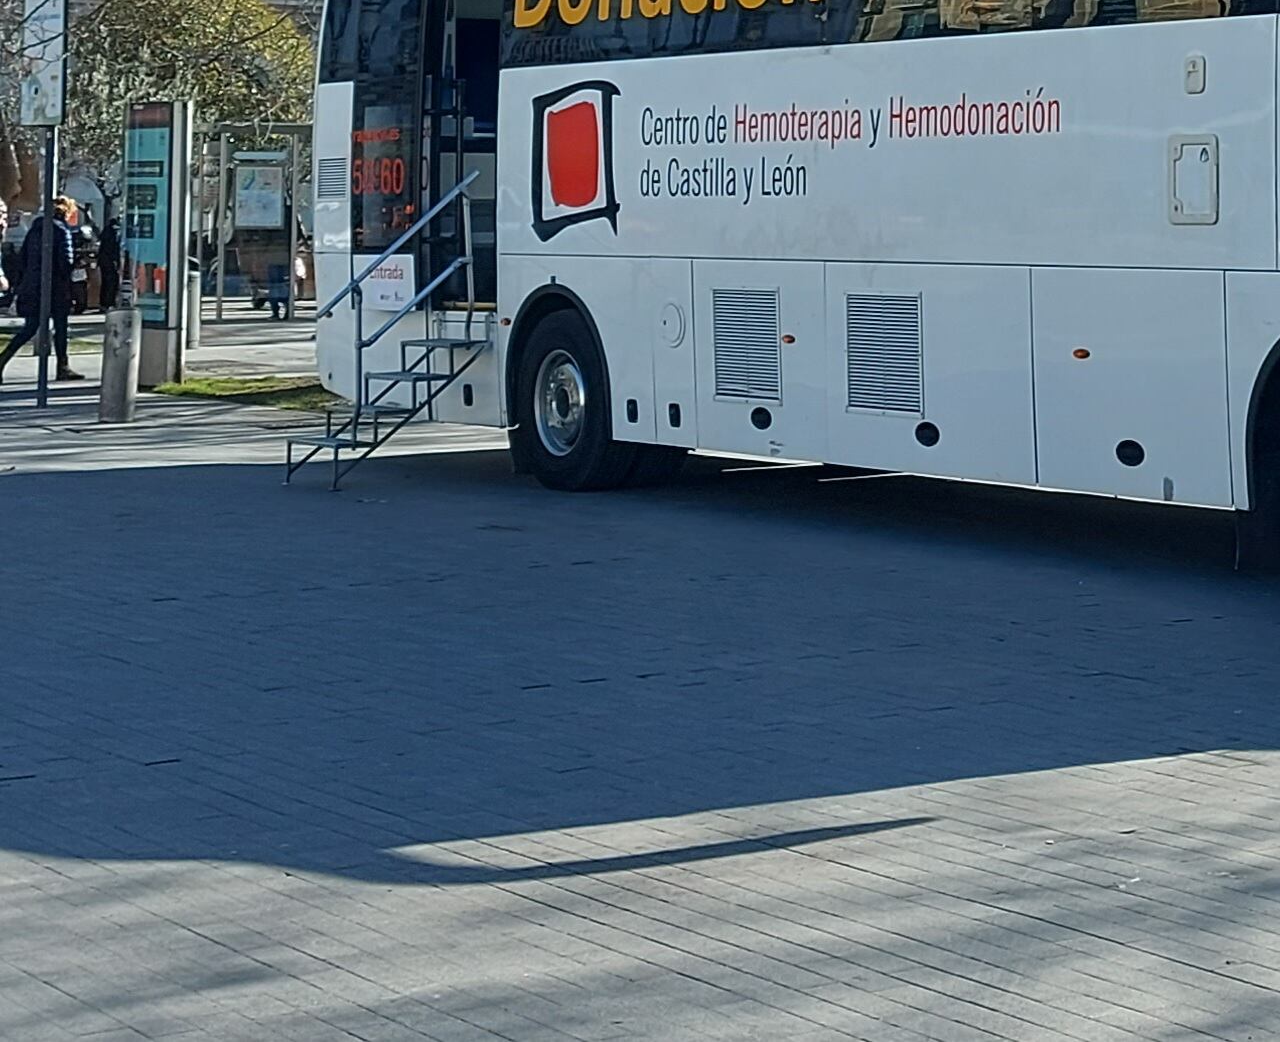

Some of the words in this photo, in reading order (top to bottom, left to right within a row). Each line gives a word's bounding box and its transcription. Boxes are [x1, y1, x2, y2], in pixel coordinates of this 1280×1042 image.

[641, 107, 699, 147] Centro
[705, 104, 728, 144] de
[734, 99, 862, 150] Hemoterapia
[869, 107, 881, 149] y
[889, 87, 1061, 140] Hemodonación
[640, 158, 661, 197] de
[667, 156, 736, 198] Castilla
[743, 167, 754, 206] y
[761, 154, 807, 197] León
